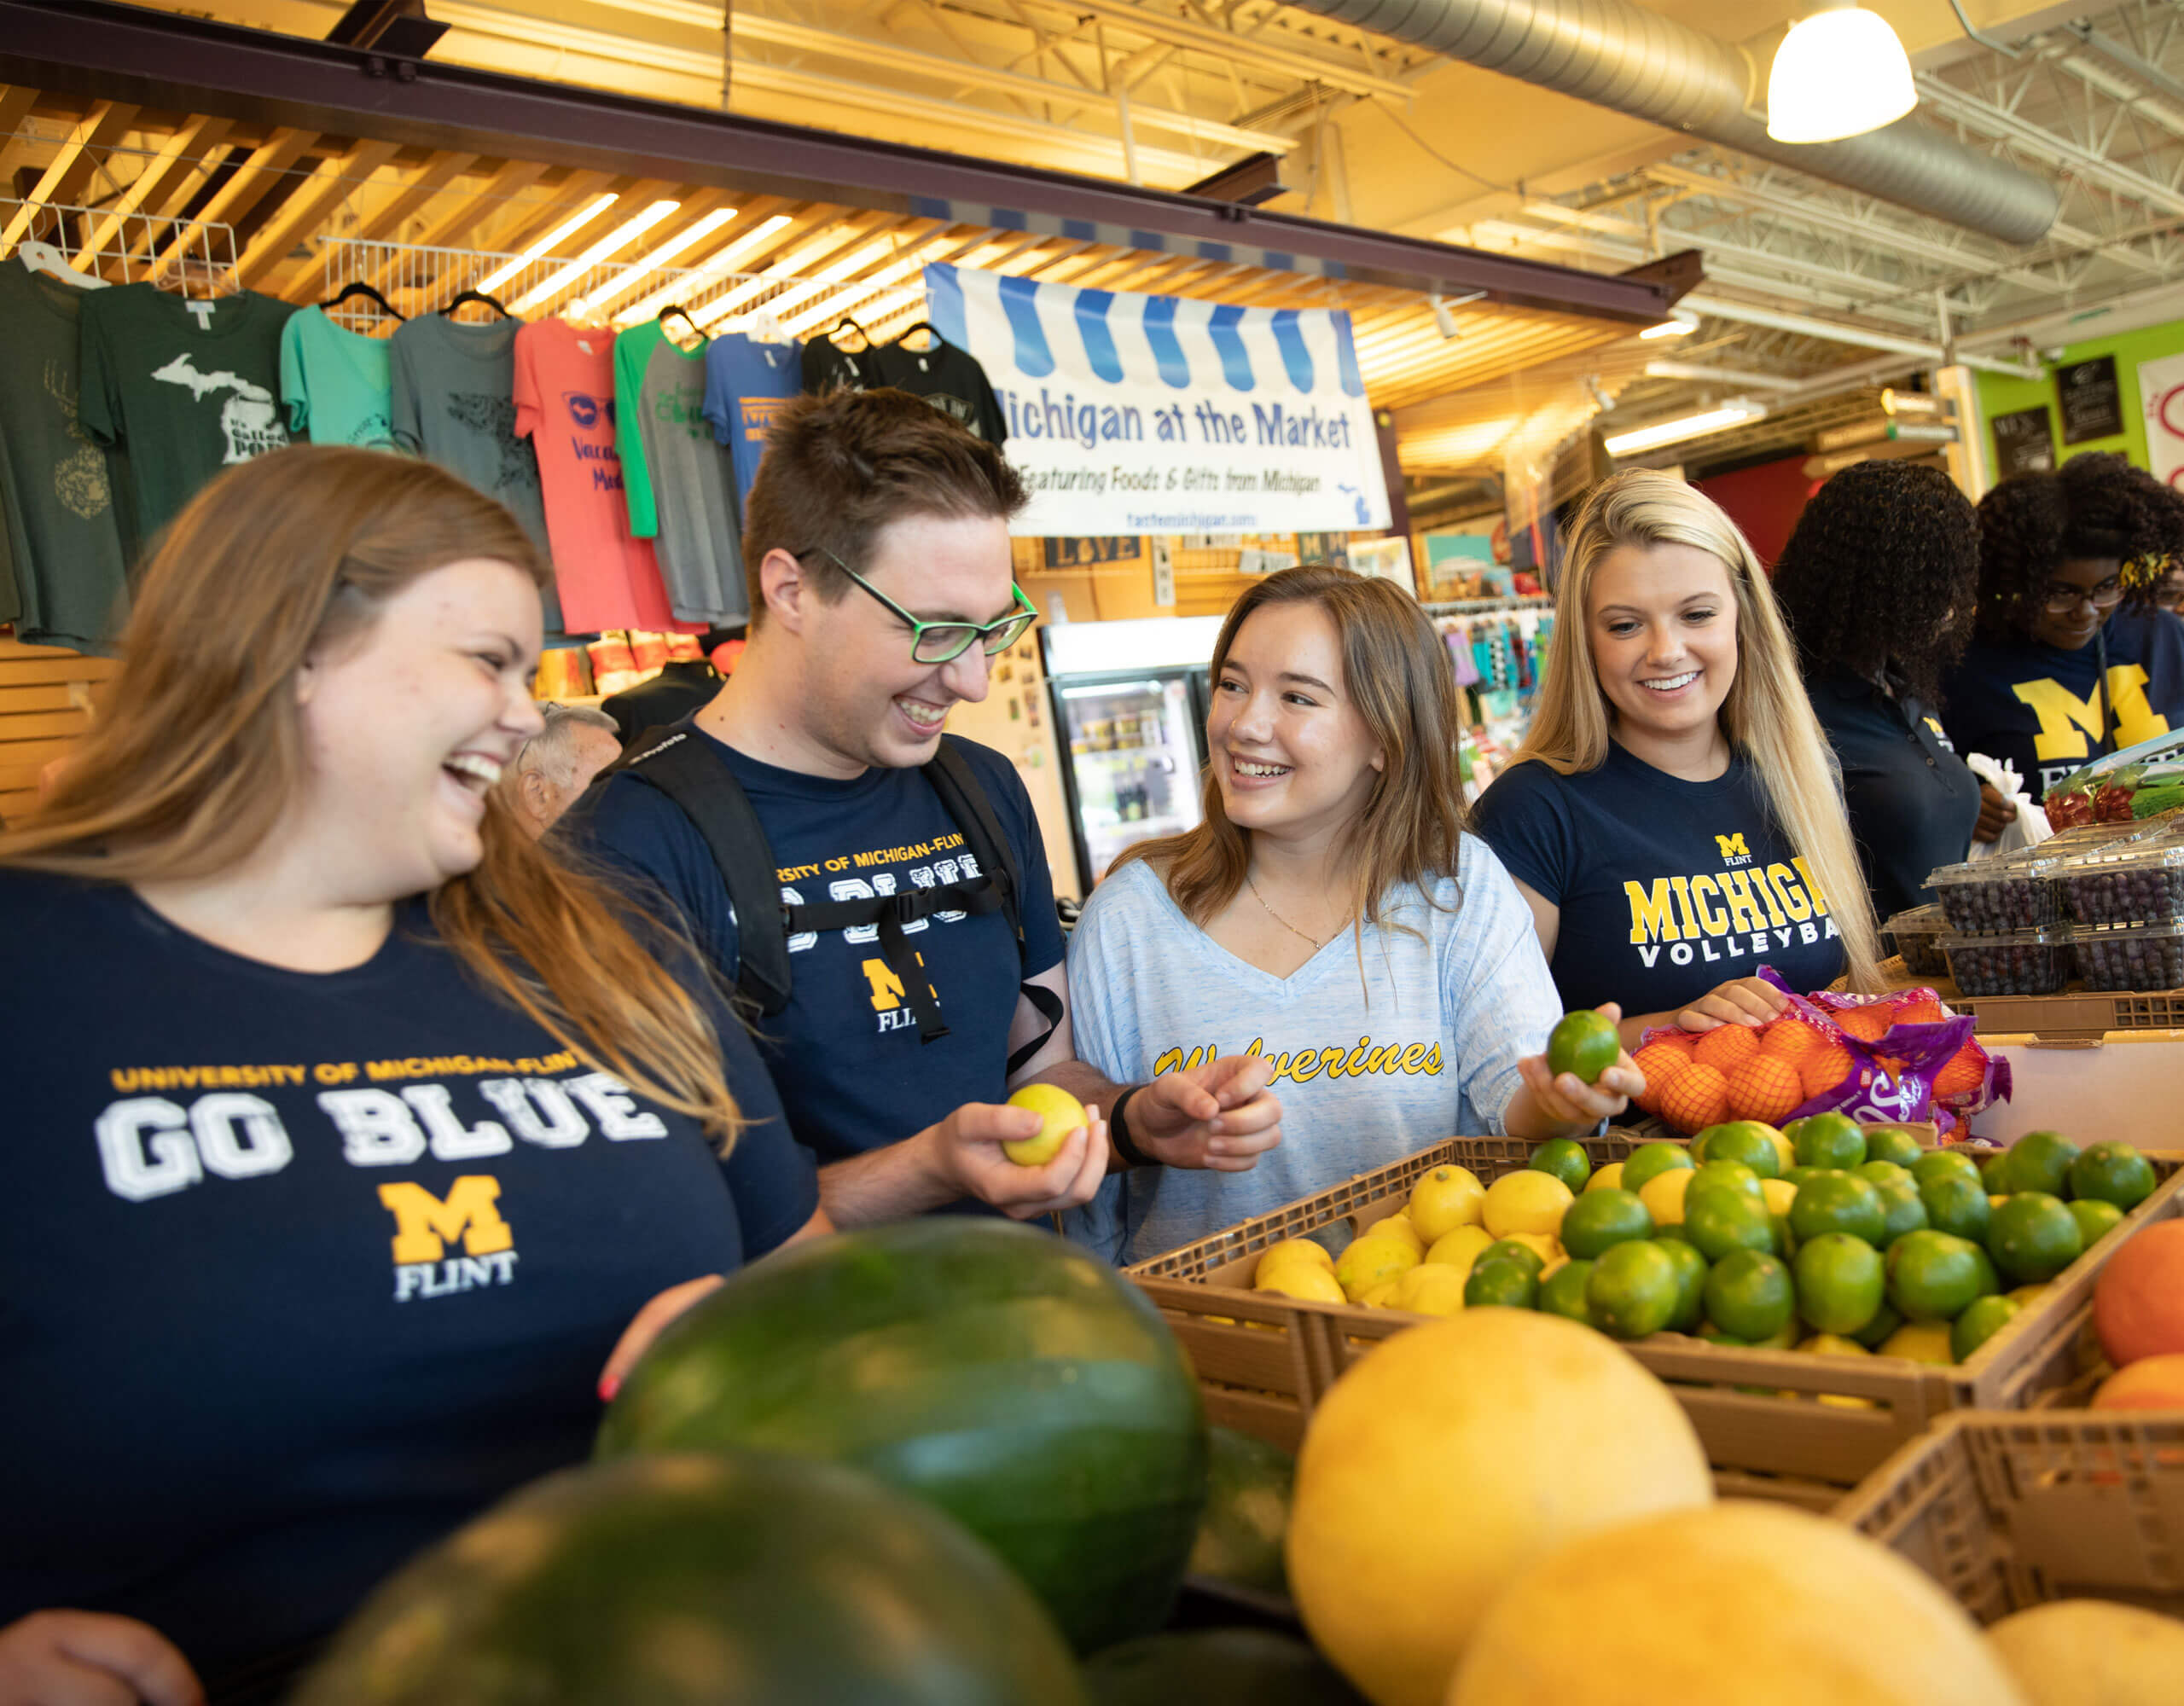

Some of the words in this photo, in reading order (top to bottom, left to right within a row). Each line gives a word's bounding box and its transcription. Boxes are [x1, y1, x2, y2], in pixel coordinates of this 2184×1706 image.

[1154, 403, 1187, 443] at
[1194, 399, 1247, 444] the
[1252, 402, 1350, 449] Market
[1019, 465, 1107, 495] Featuring
[1112, 466, 1159, 491] Foods
[1182, 467, 1220, 491] Gifts
[1225, 467, 1258, 492] from
[1263, 469, 1321, 496] Michigan
[824, 856, 851, 872] OF
[853, 832, 966, 868] MICHIGAN-FLIN
[1714, 832, 1751, 858] M
[1724, 854, 1753, 867] FLINT
[110, 1065, 306, 1093] UNIVERSITY
[313, 1061, 360, 1085] OF
[364, 1049, 580, 1082] MICHIGAN-FLIN
[95, 1095, 294, 1203] GO
[316, 1072, 669, 1167] BLUE
[377, 1175, 514, 1266] M
[393, 1250, 520, 1303] FLINT
